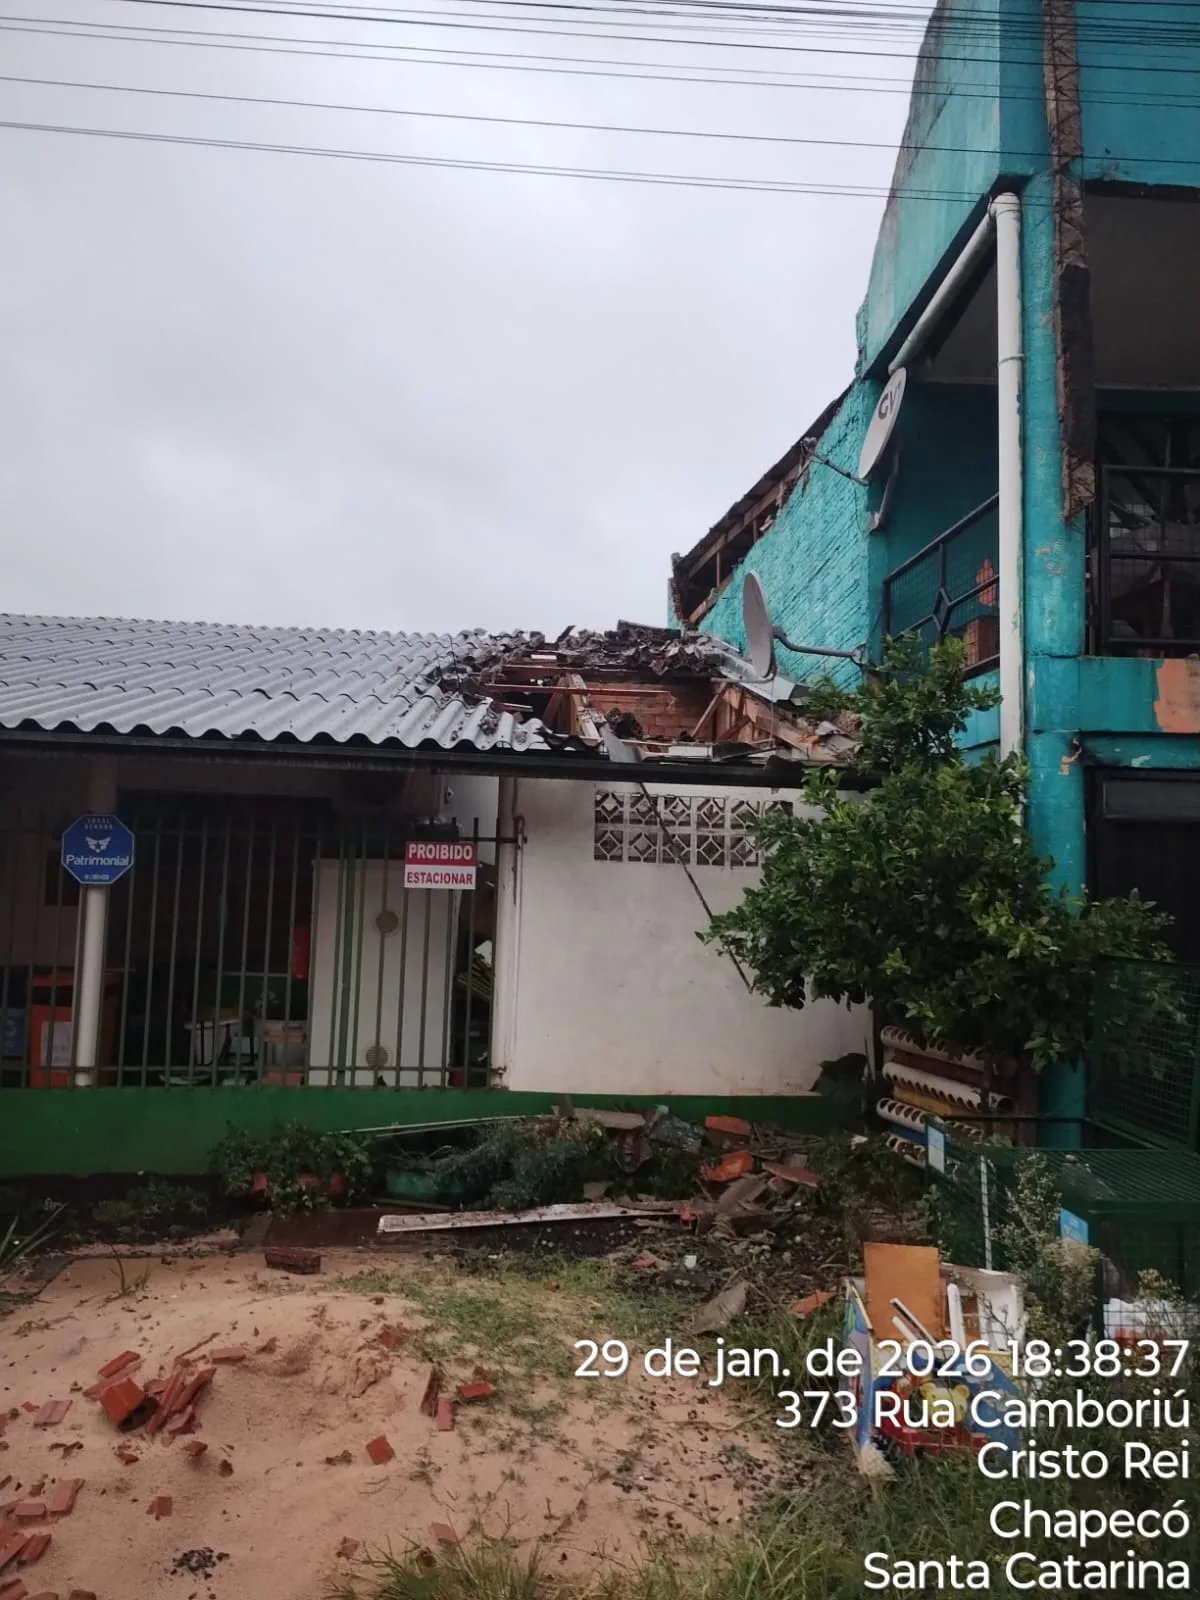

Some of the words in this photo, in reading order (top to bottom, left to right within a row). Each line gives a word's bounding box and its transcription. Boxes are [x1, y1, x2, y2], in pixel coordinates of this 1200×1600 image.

[408, 844, 473, 860] PROIBIDO
[65, 854, 130, 866] Patrimonial
[407, 871, 473, 885] ESTACIONAR
